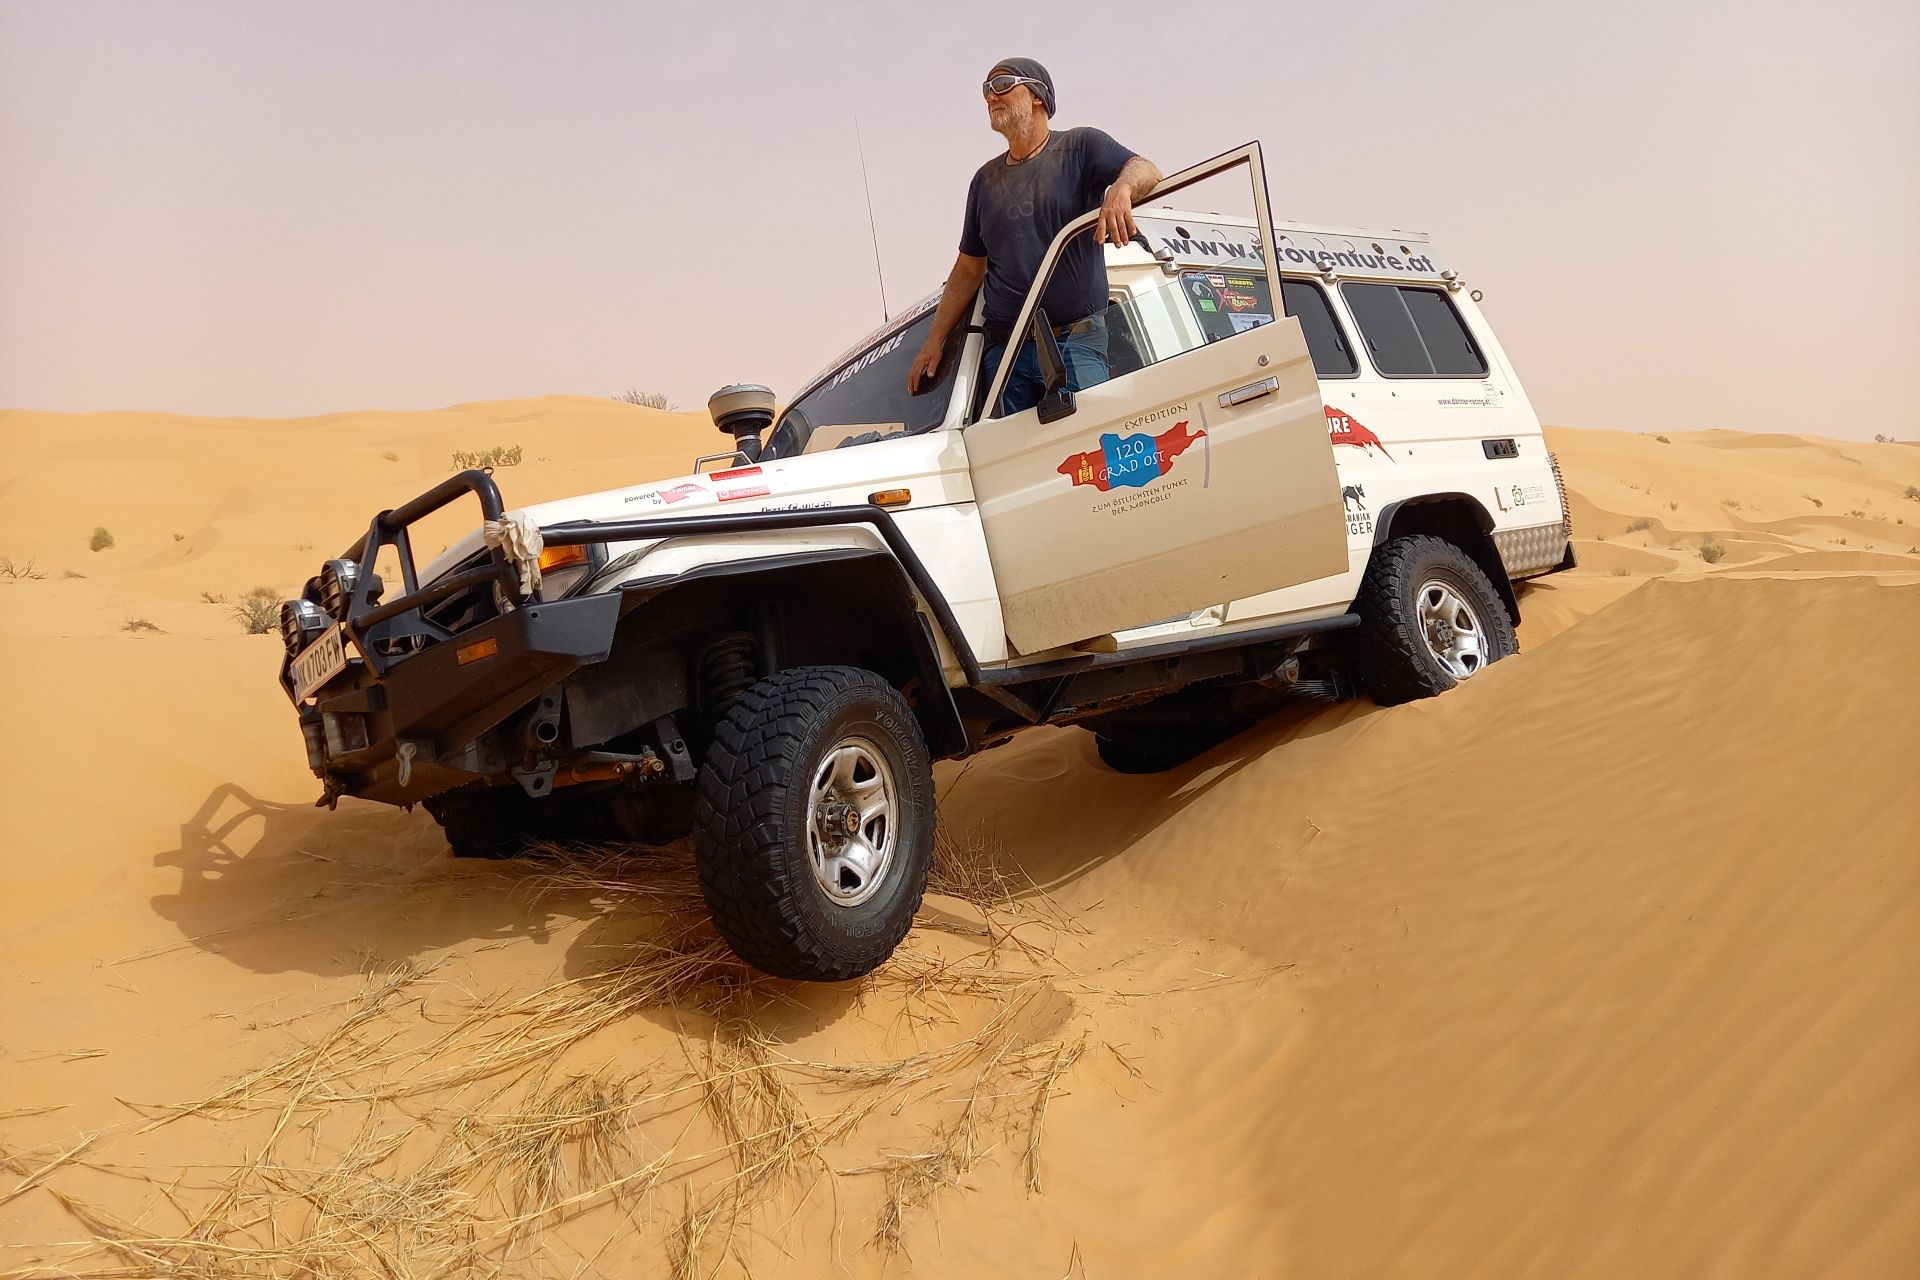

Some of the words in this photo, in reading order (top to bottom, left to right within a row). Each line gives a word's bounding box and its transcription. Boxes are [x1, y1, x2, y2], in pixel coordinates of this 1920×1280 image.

[1124, 402, 1188, 430] EXPEDITION
[1116, 440, 1144, 460] 120
[1099, 459, 1138, 482] GRAD
[1143, 450, 1165, 466] OST
[624, 491, 655, 503] powered
[652, 497, 662, 505] by
[1092, 502, 1111, 513] ZUM
[1161, 478, 1188, 492] PUNKT
[1111, 506, 1128, 516] DER
[1129, 492, 1172, 511] MONGOLEI
[1346, 512, 1371, 523] MANIAN
[1346, 521, 1373, 536] IGER
[874, 706, 925, 822] YOKOHAMA
